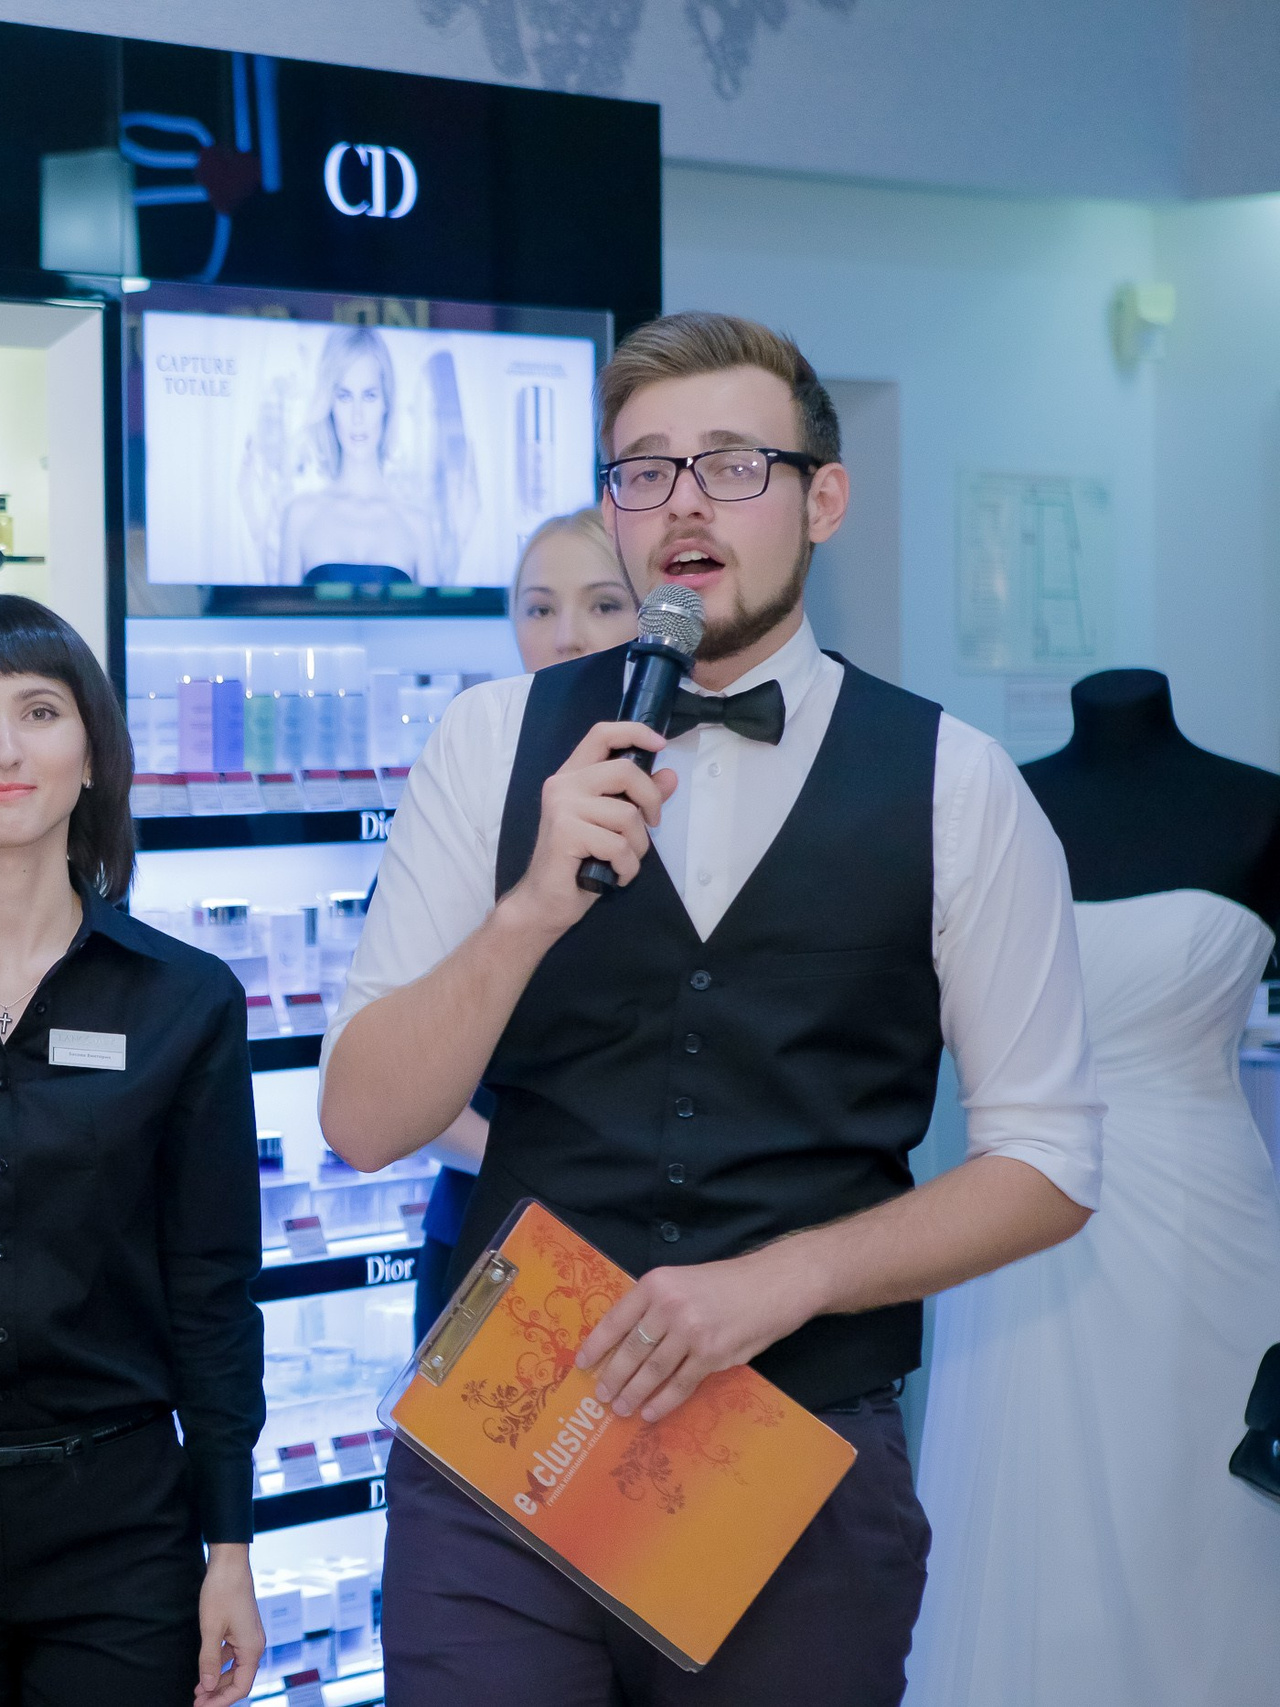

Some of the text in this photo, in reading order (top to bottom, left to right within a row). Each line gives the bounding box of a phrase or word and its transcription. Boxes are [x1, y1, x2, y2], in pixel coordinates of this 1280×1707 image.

[323, 140, 419, 219] CD
[155, 353, 238, 376] CAPTURE
[164, 377, 232, 397] TOTALE
[365, 1254, 416, 1286] Dior
